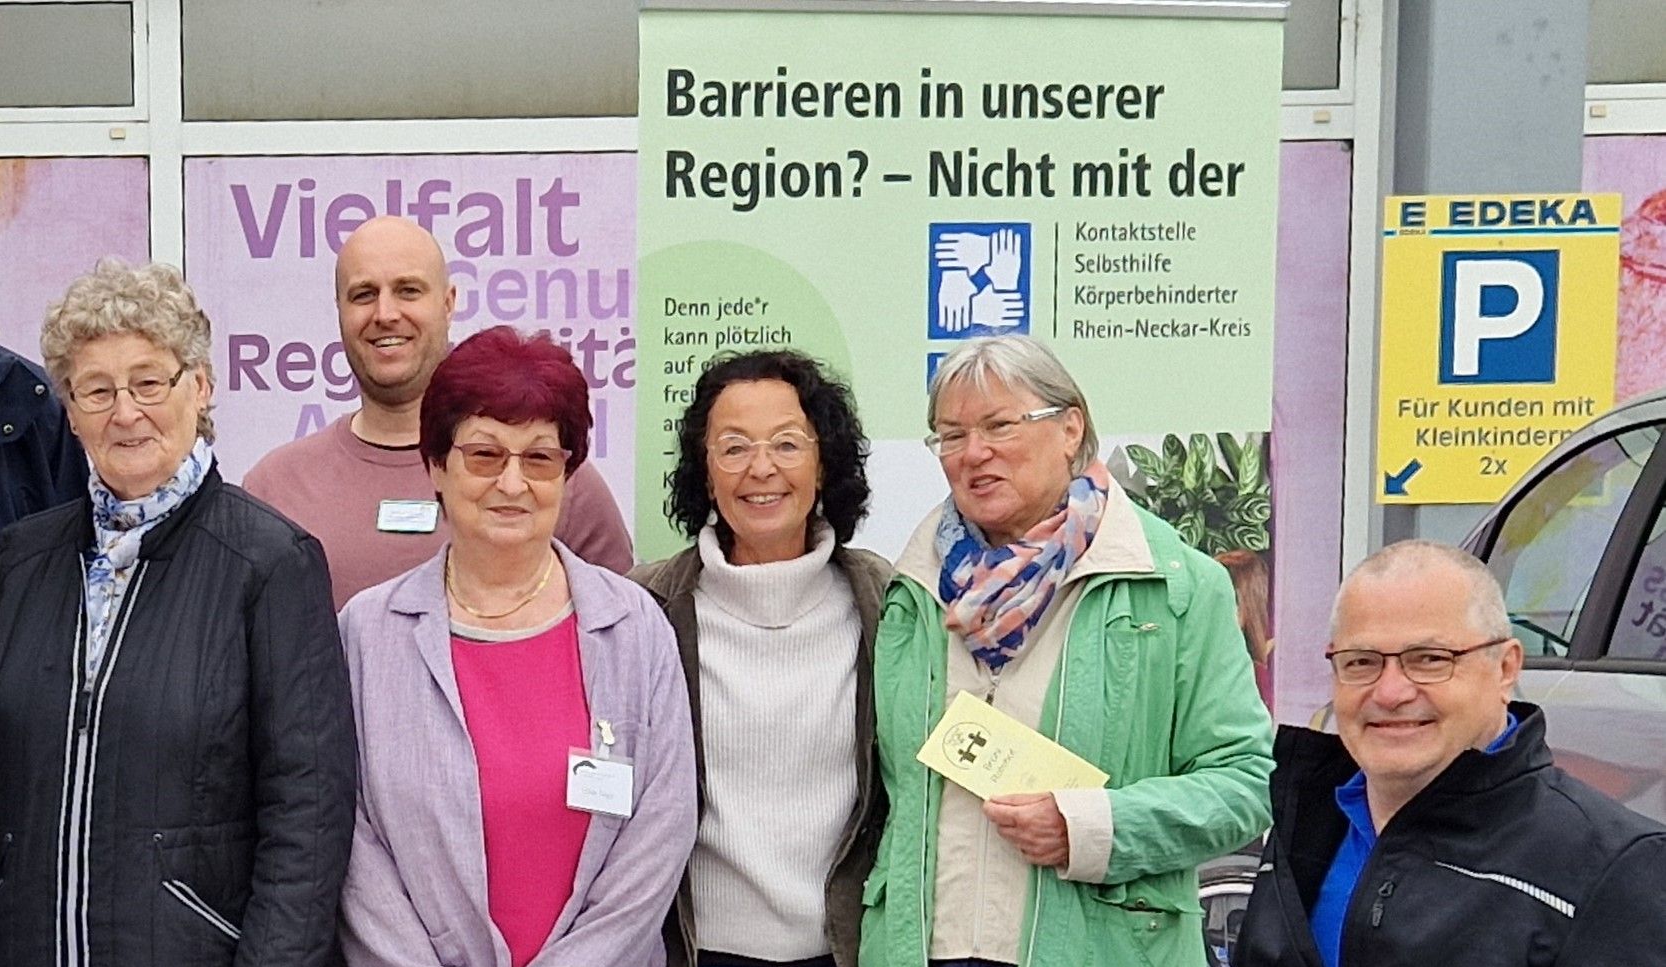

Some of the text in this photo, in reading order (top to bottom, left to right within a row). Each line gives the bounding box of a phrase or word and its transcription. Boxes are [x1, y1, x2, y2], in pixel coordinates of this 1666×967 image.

[666, 66, 1165, 120] Barrieren in unserer
[665, 146, 869, 212] Region?
[930, 148, 1056, 198] Nicht
[1072, 148, 1152, 198] mit
[1168, 148, 1245, 198] der
[1448, 198, 1597, 227] EDEKA
[1075, 221, 1197, 242] Kontaktstelle
[1074, 253, 1173, 274] Selbsthilfe
[664, 297, 710, 316] Denn
[1074, 284, 1239, 310] Körperbehinderter
[1073, 318, 1252, 339] Rhein-Neckar-Kreis
[1452, 260, 1544, 376] P
[663, 326, 792, 349] kann plötzlich
[663, 354, 695, 375] auf
[1398, 397, 1595, 418] Für Kunden mit
[1480, 456, 1508, 475] 2x
